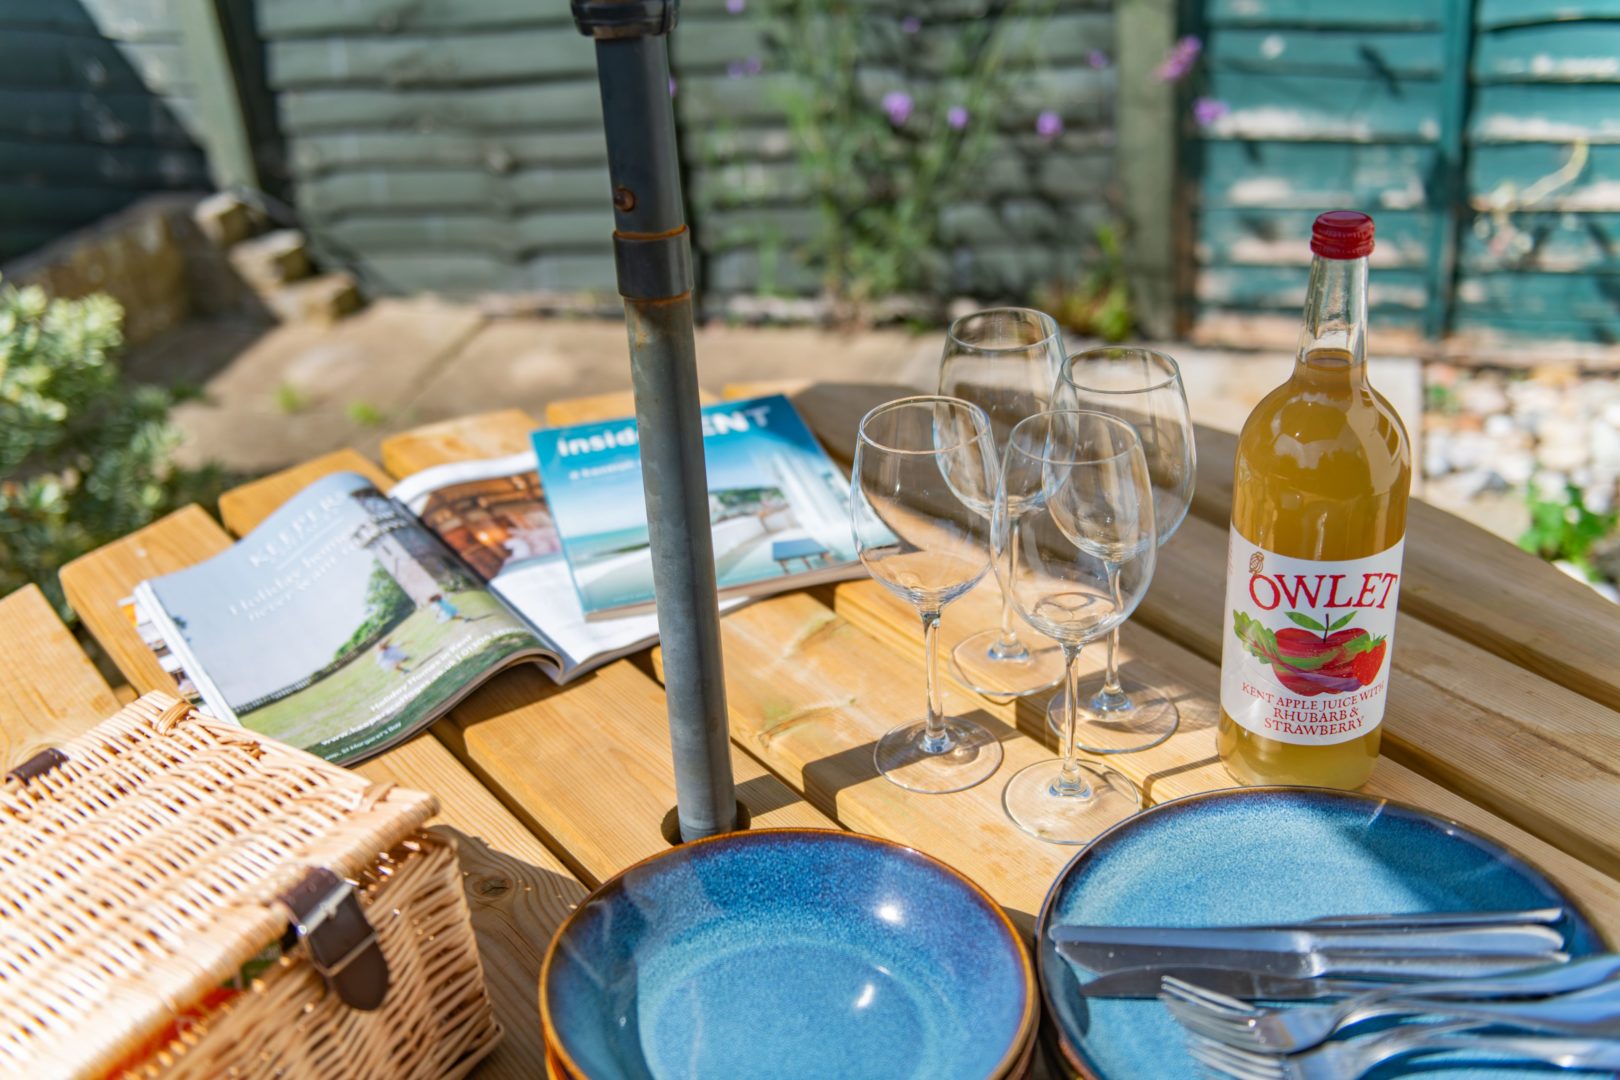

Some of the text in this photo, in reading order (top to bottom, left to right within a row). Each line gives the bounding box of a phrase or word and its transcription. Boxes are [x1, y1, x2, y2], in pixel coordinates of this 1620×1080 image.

[557, 405, 770, 457] insid ENT
[1249, 572, 1398, 610] OWLET
[1242, 681, 1385, 712] KENT APPLE JUICE WITH
[1264, 717, 1363, 736] STRAWBERRY
[1273, 706, 1359, 723] RHUBARB &
